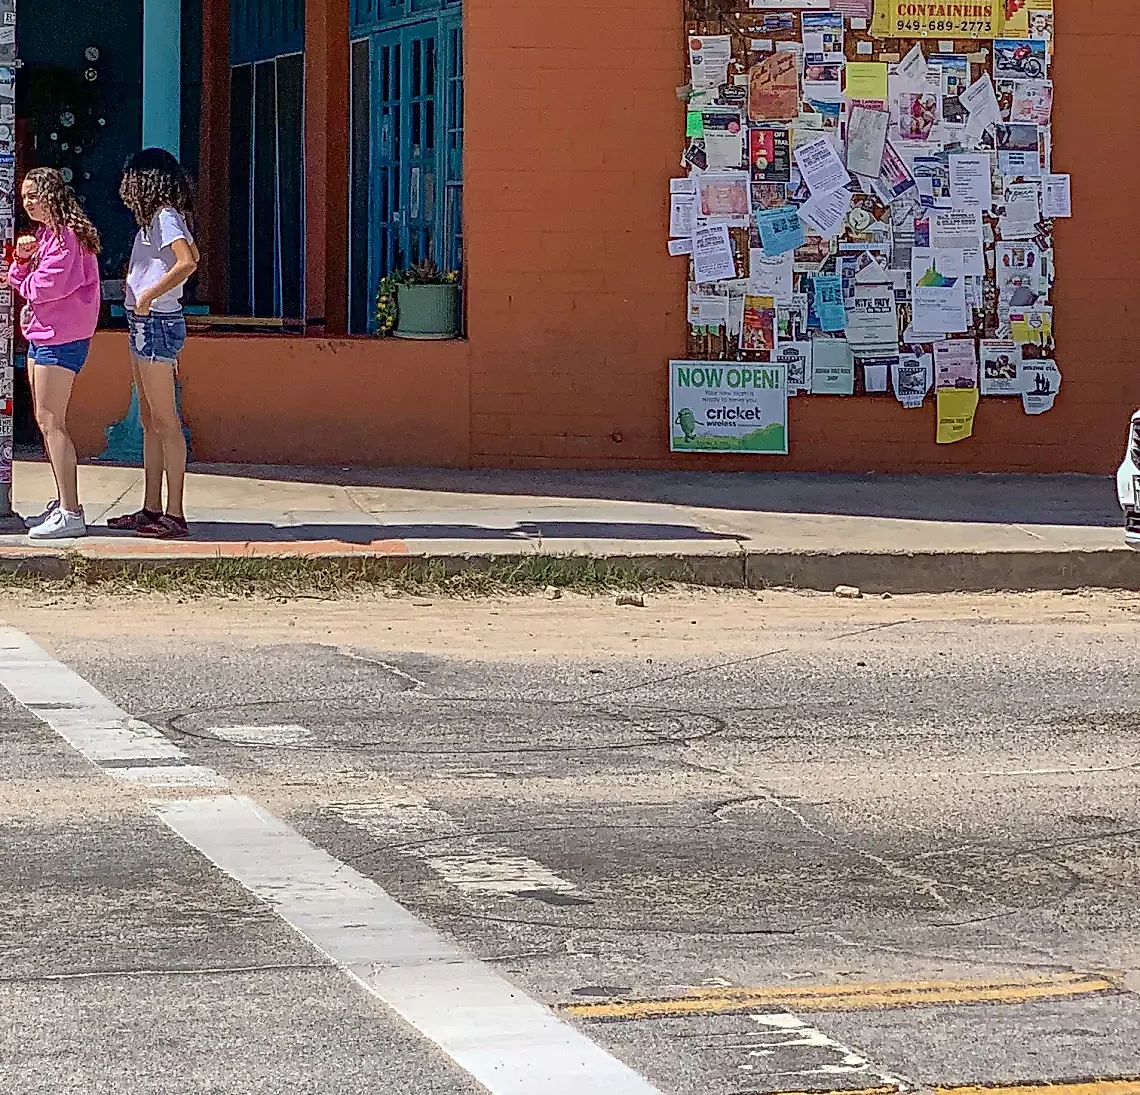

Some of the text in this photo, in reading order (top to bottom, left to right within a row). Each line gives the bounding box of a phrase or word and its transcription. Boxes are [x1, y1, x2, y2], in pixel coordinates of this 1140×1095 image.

[897, 3, 992, 17] CONTAINERS
[896, 20, 992, 32] 949-689-2773
[677, 367, 780, 389] NOW OPEN!
[706, 405, 762, 420] cricket
